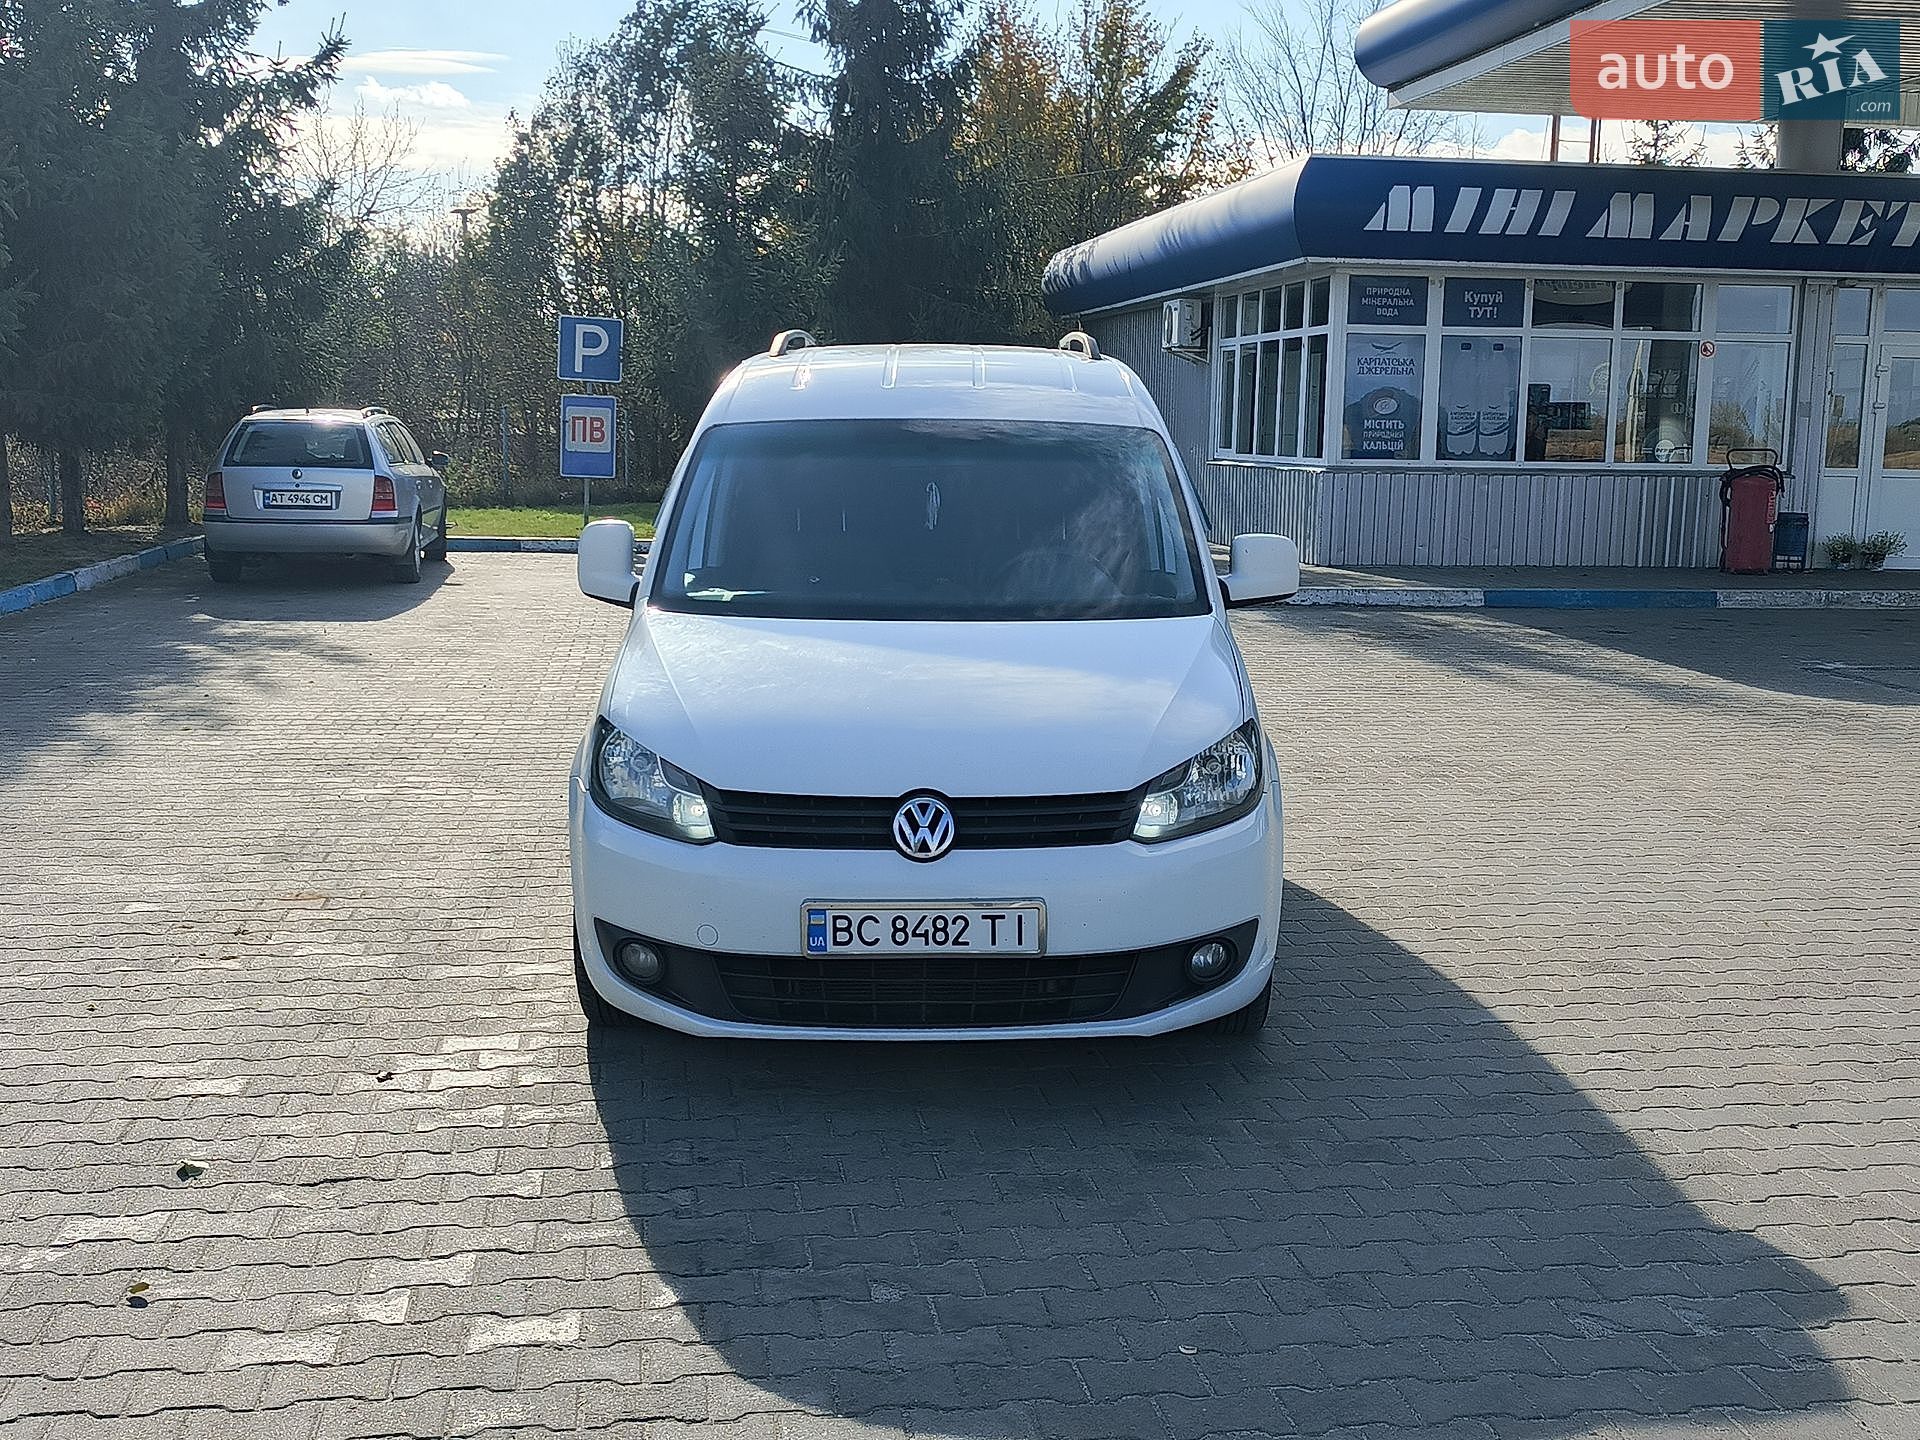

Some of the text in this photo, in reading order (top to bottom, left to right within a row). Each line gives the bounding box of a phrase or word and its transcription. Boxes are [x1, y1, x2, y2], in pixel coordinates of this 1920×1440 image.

[1363, 185, 1577, 237] МІНІ
[1366, 287, 1411, 297] ПРИРОДНА
[1464, 291, 1503, 304] Купуй
[1361, 297, 1415, 306] МІНЕРАЛЬНА
[1376, 307, 1399, 317] ВОДА
[1468, 307, 1498, 319] ТУТ!
[574, 323, 609, 373] P
[1357, 357, 1415, 367] КАРПАТСЬКА
[1356, 366, 1415, 376] ДЖЕРЕЛЬНА
[571, 416, 606, 443] ПВ
[1363, 419, 1405, 430] МІСТИТЬ
[1362, 439, 1404, 451] КАЛЬЦІЙ
[270, 493, 285, 503] AT
[313, 494, 328, 504] CM
[831, 914, 881, 946] BC
[890, 914, 970, 946] 8482
[809, 936, 825, 947] UA
